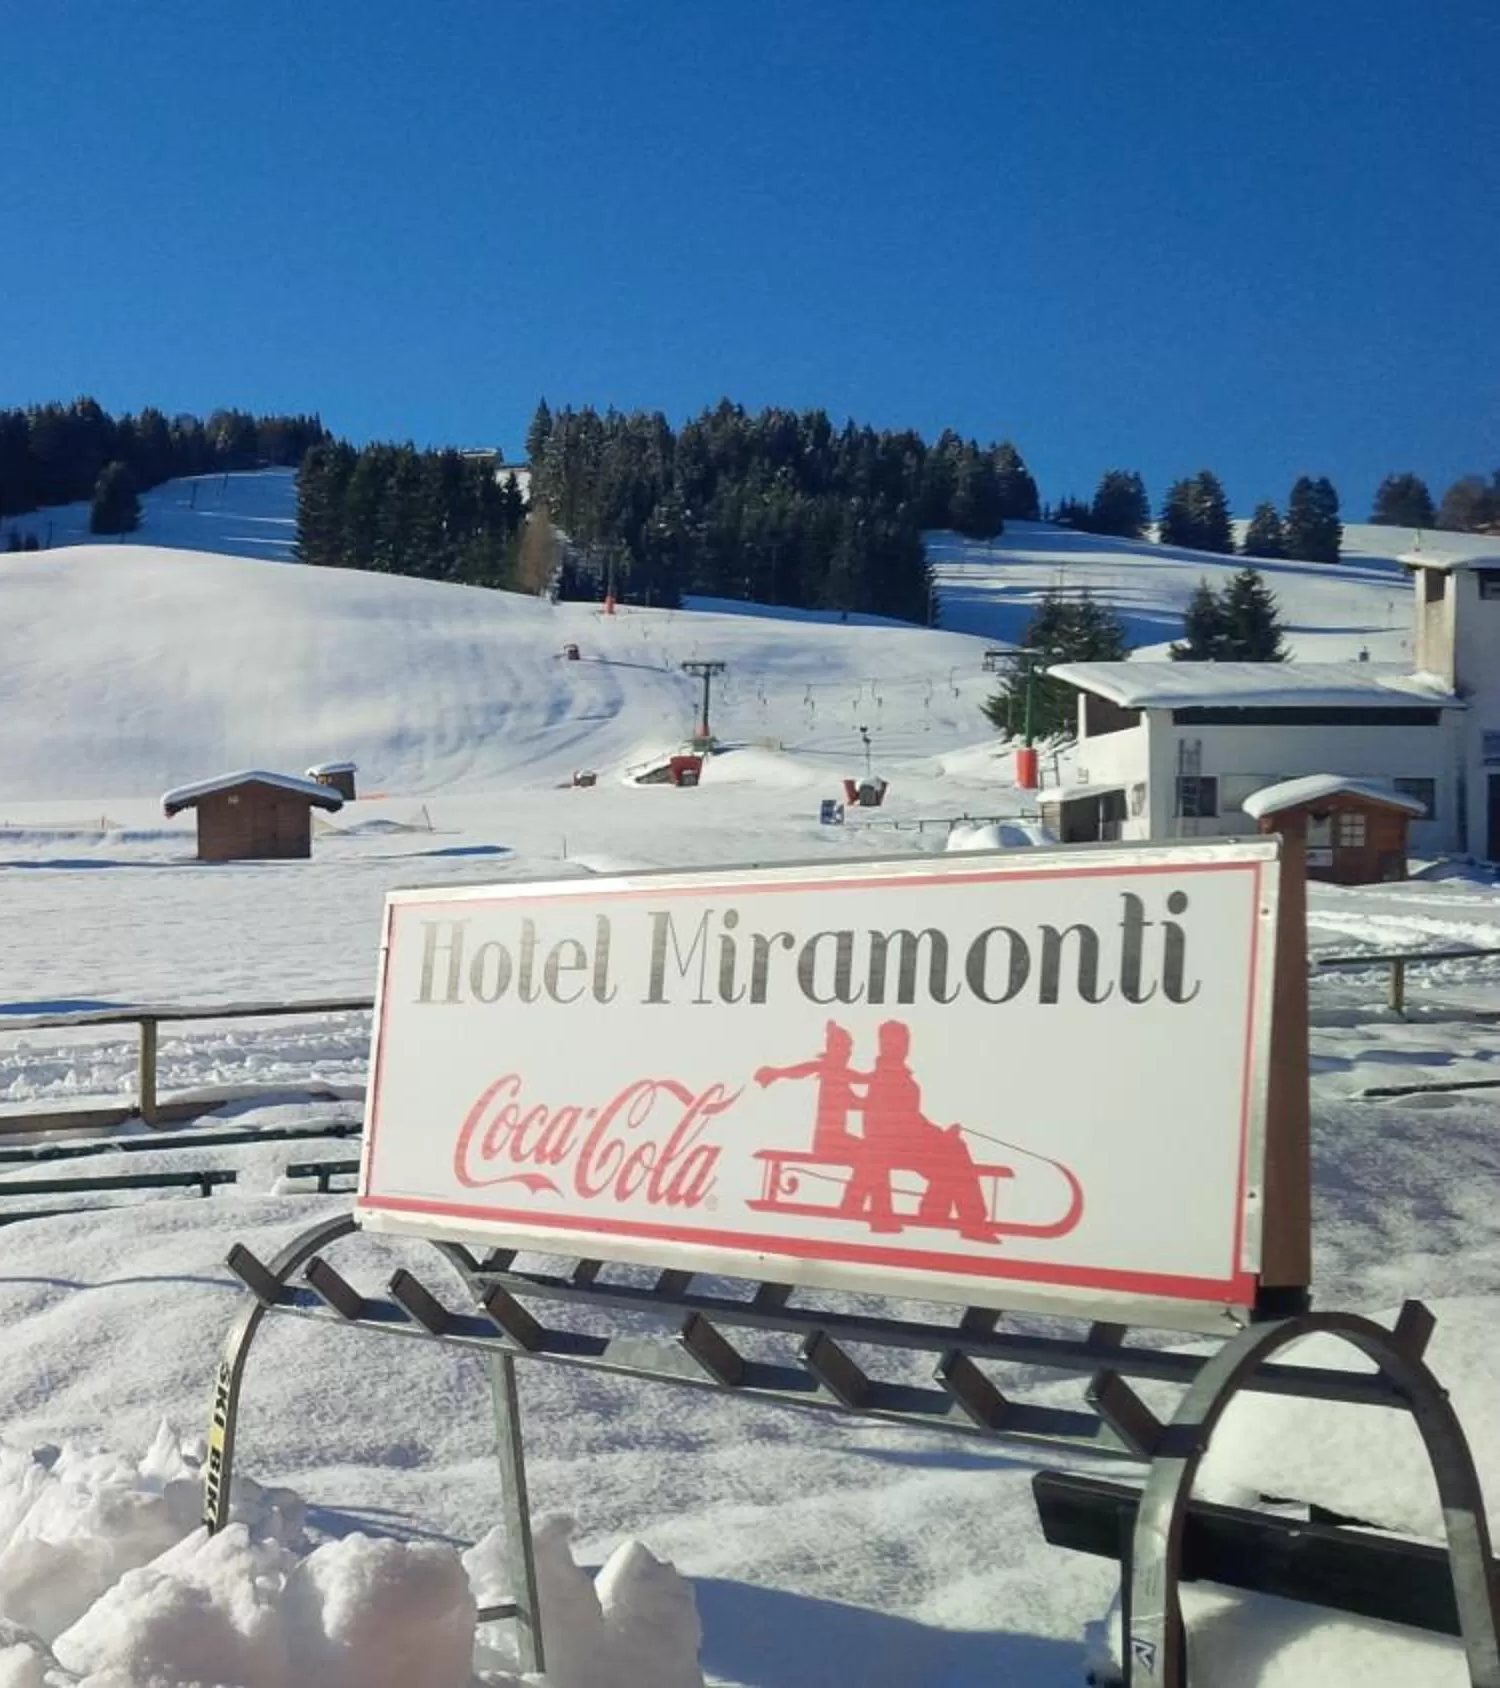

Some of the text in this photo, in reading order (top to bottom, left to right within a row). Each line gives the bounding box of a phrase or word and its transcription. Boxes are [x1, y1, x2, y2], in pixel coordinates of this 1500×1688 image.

[413, 890, 1202, 1006] Hotel Miramonti
[212, 1361, 231, 1429] SKI
